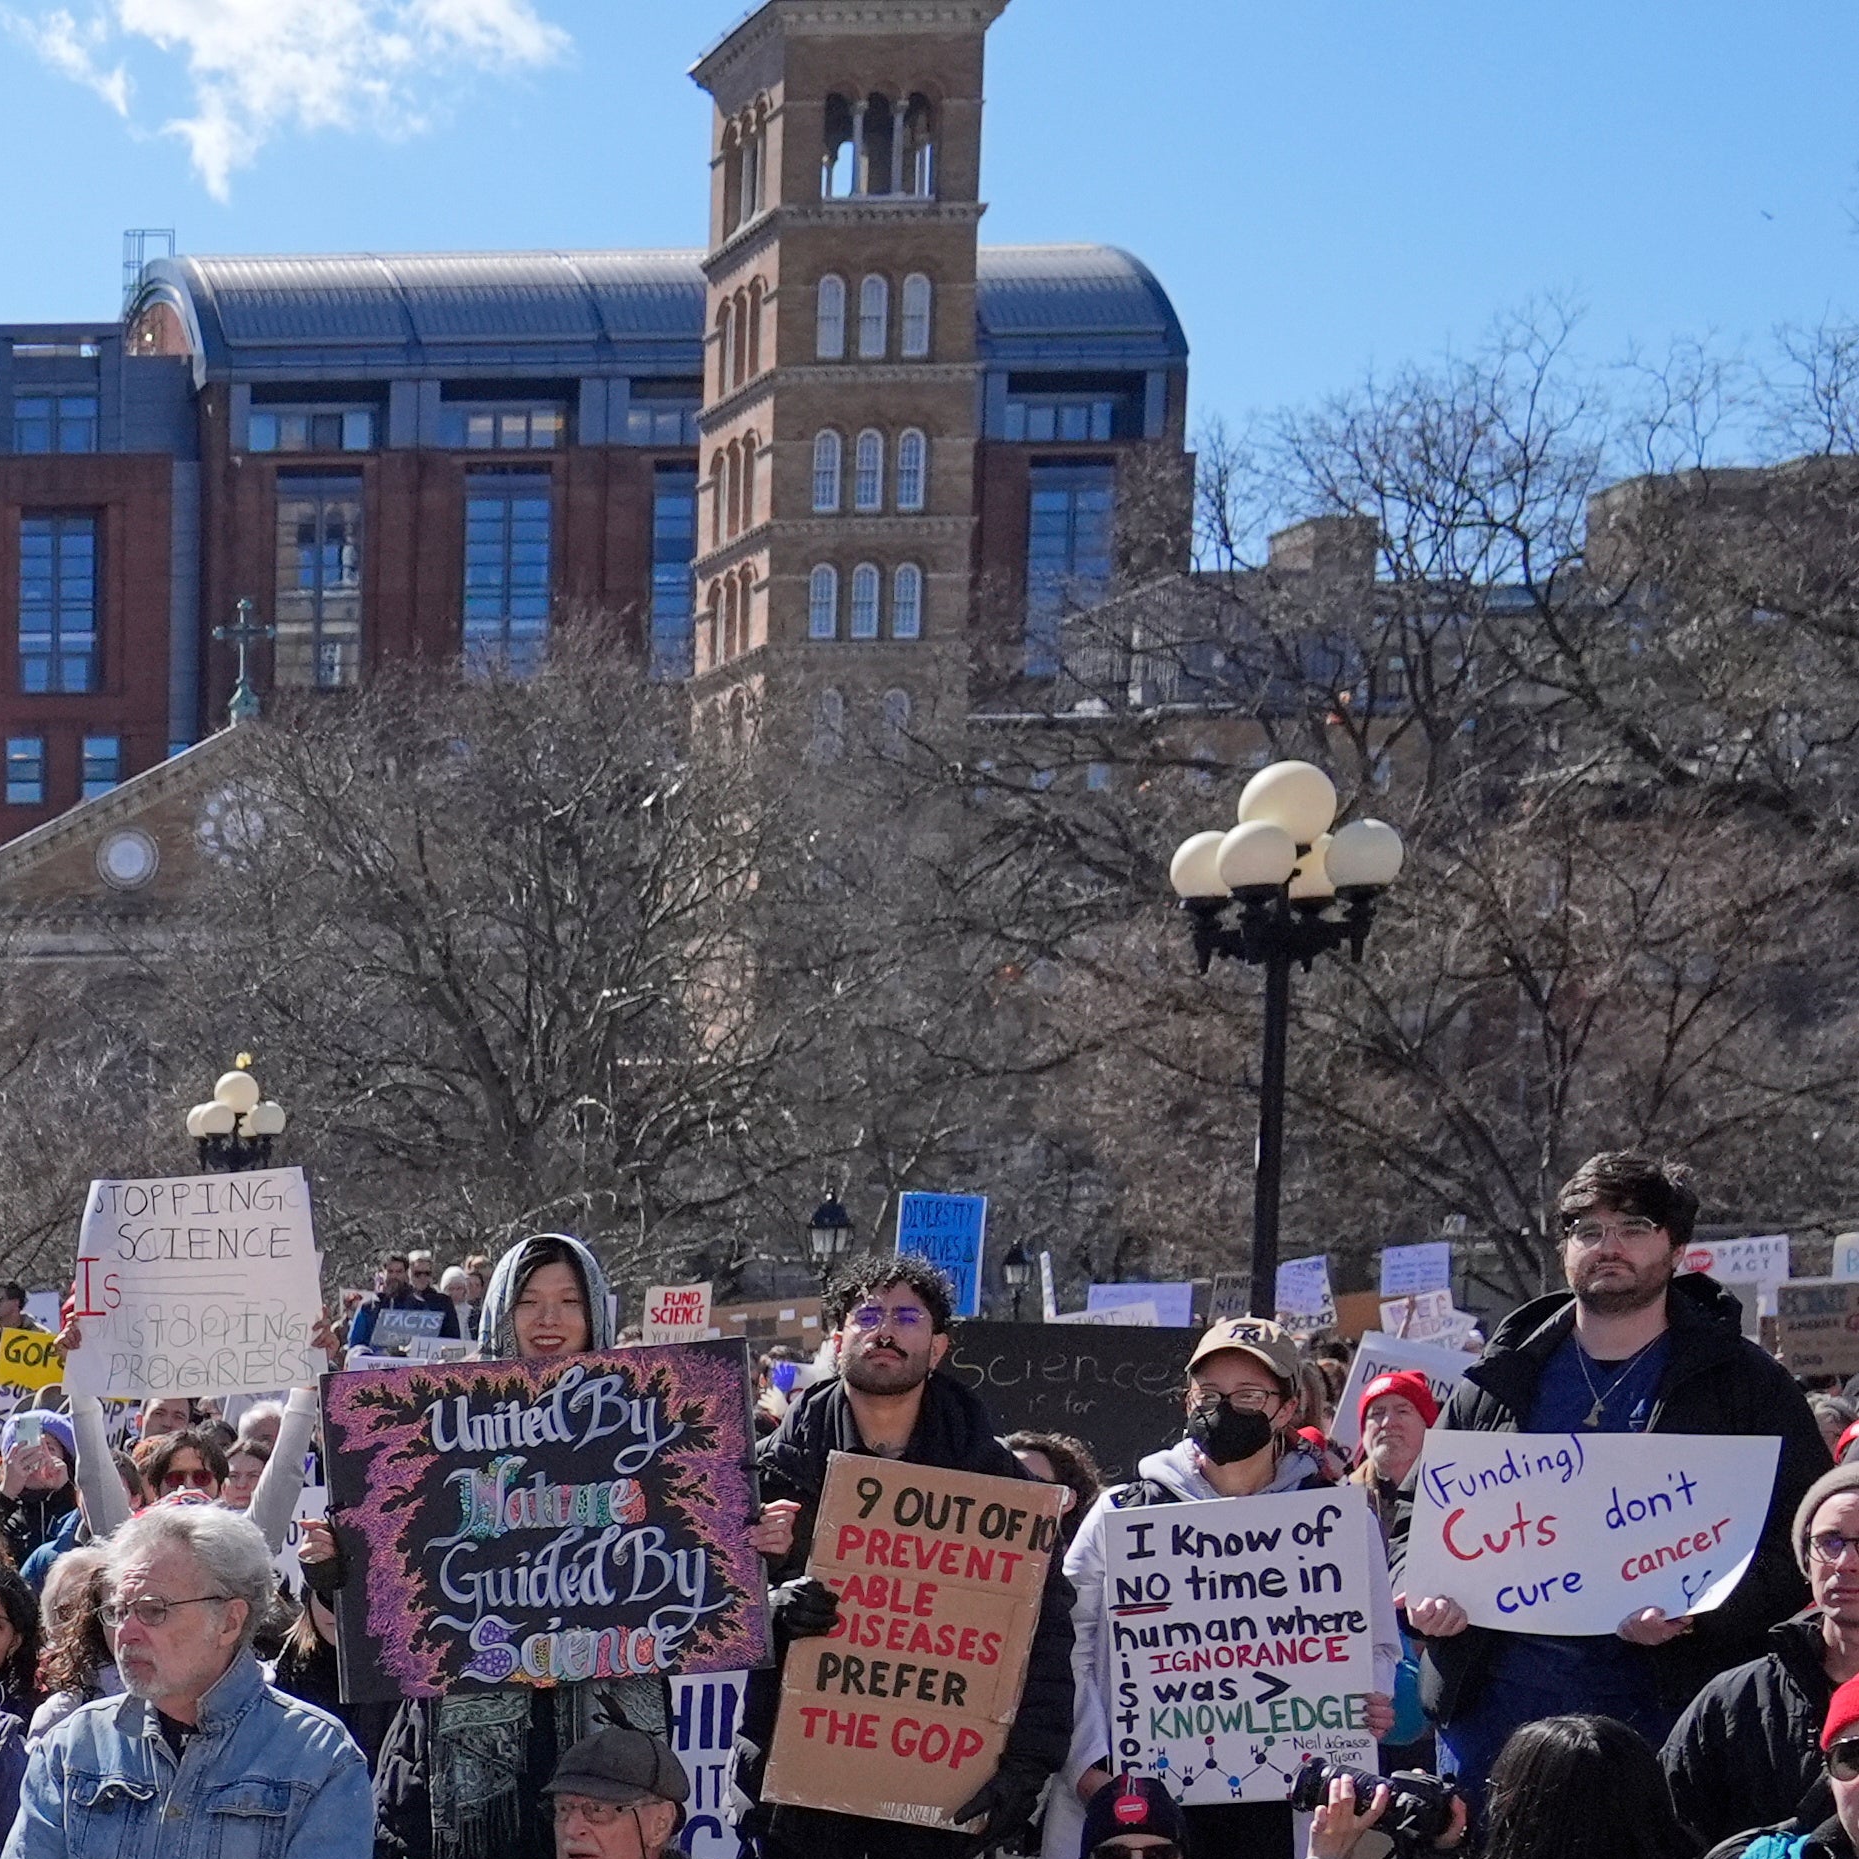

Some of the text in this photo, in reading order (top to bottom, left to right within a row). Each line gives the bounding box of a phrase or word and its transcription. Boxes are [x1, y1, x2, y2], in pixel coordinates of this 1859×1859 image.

[94, 1180, 282, 1216] STOPPING
[118, 1223, 292, 1262] SCIENCE
[383, 1311, 442, 1330] FACTS
[650, 1304, 705, 1325] SCIENCE
[663, 1291, 701, 1307] FUND
[424, 1365, 686, 1474] United By
[1422, 1433, 1584, 1509] (Funding)
[423, 1455, 647, 1554] Nature
[855, 1477, 1058, 1554] 9 OUT OF 10
[1442, 1470, 1698, 1561] Cuts don't
[835, 1523, 1024, 1585] PREVENT
[1126, 1522, 1156, 1561] I
[1291, 1504, 1342, 1548] of
[428, 1525, 736, 1638] Guided By
[1116, 1555, 1343, 1604] NO time in
[1495, 1517, 1731, 1614] cure cancer
[828, 1574, 938, 1618] -ABLE
[459, 1614, 683, 1685] Science
[824, 1612, 1003, 1666] DISEASES
[1113, 1605, 1368, 1652] human where
[1149, 1634, 1351, 1675] IGNORANCE
[816, 1651, 968, 1708] PREFER
[1152, 1677, 1238, 1704] was
[799, 1706, 985, 1771] THE GOP
[1149, 1693, 1369, 1741] KNOWLEDGE
[1326, 1750, 1363, 1765] Tyson
